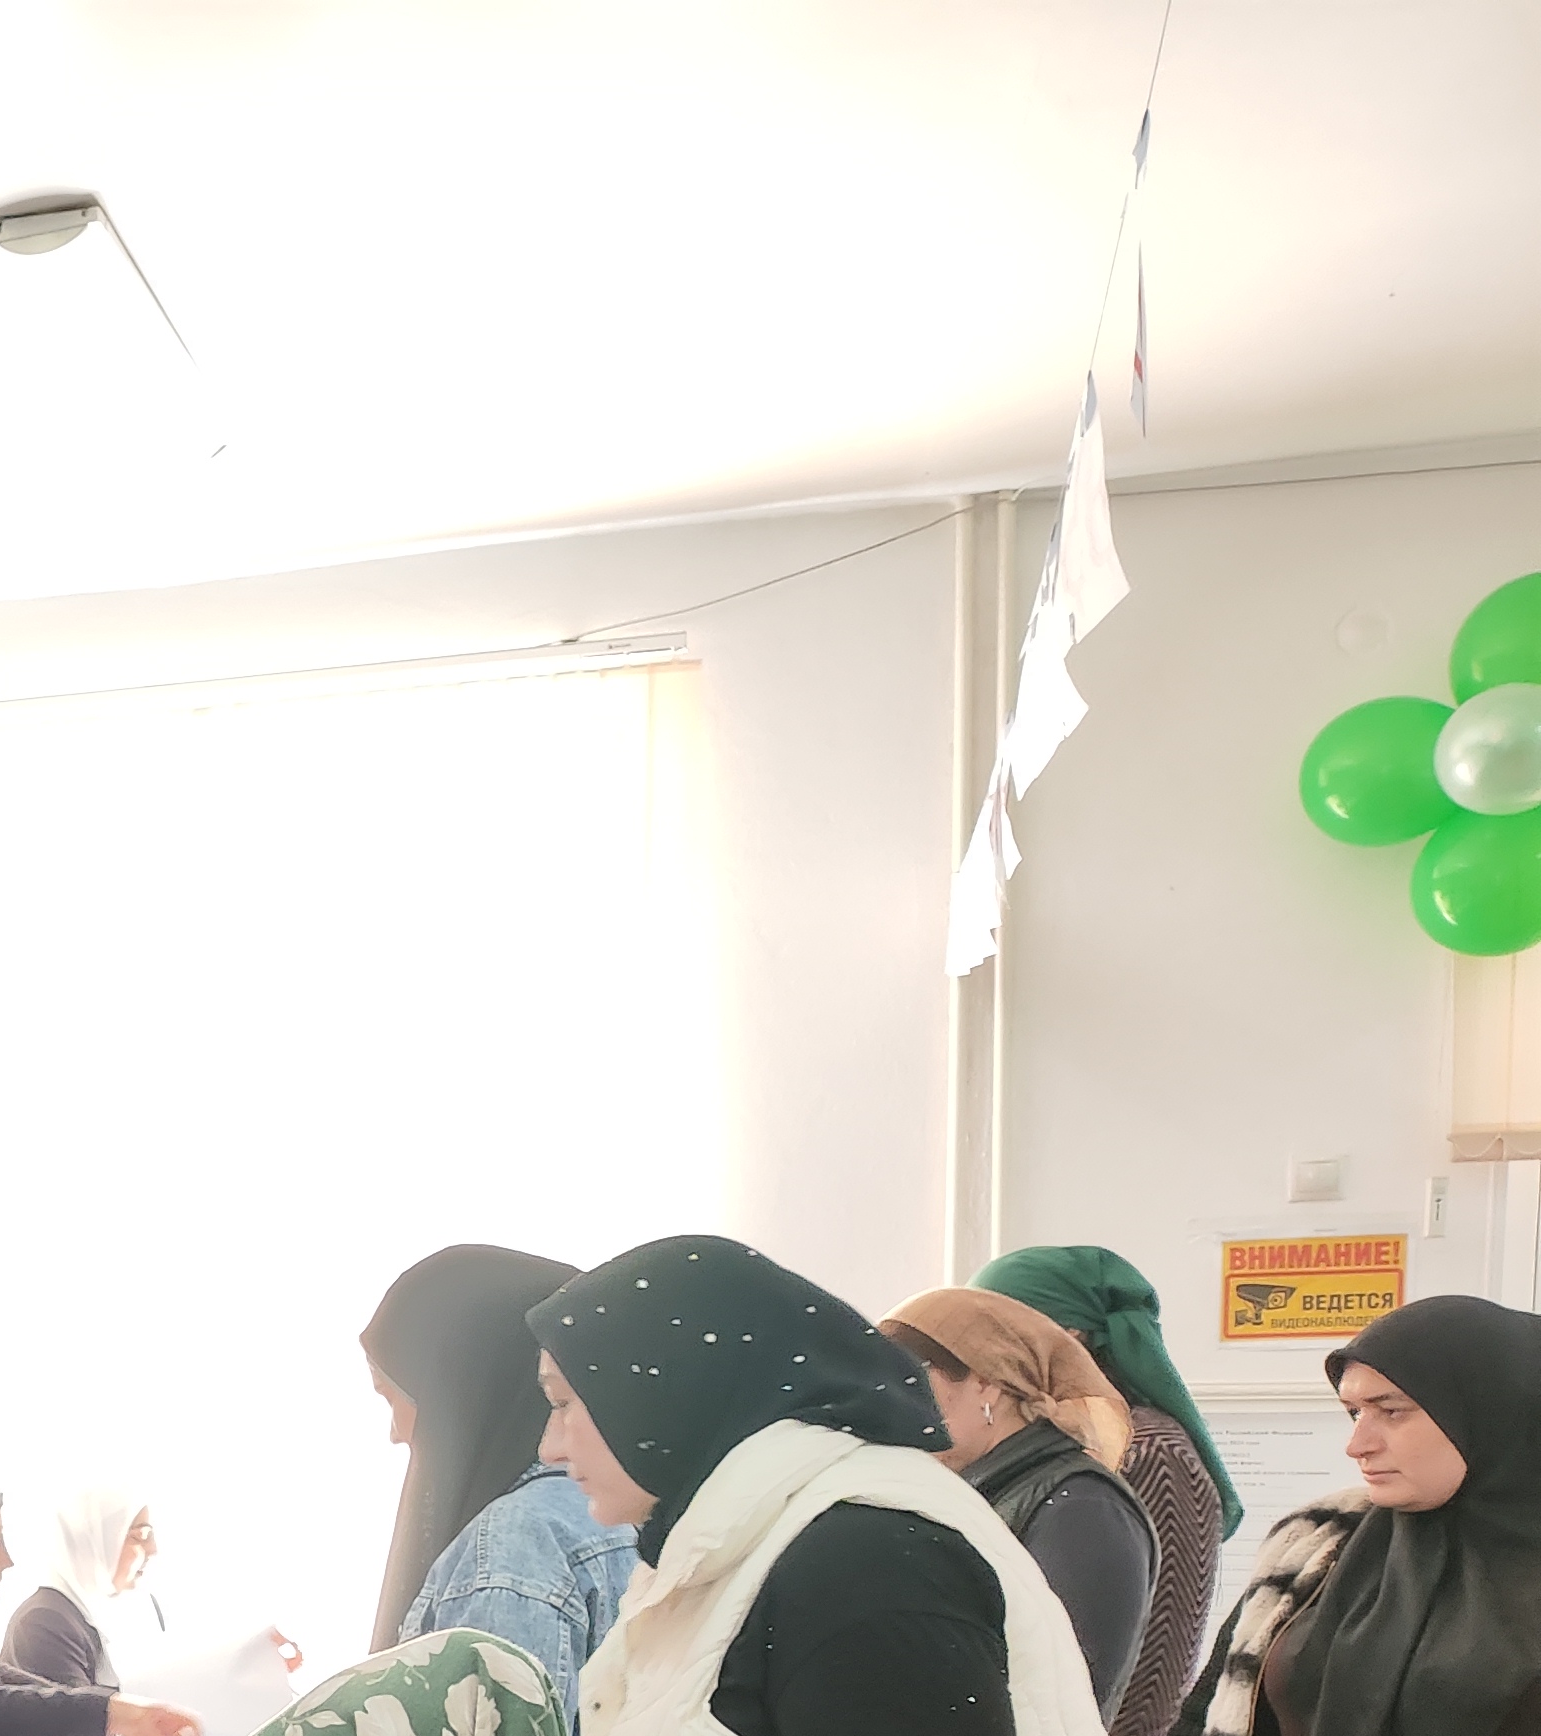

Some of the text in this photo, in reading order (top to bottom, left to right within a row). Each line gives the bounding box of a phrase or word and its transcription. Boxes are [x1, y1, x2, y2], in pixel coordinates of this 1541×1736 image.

[1229, 1241, 1401, 1270] ВНИМАНИЕ!
[1302, 1292, 1394, 1313] ВЕДЕТСЯ
[1271, 1315, 1378, 1329] ВИДЕОНАБЛЮДЕ
